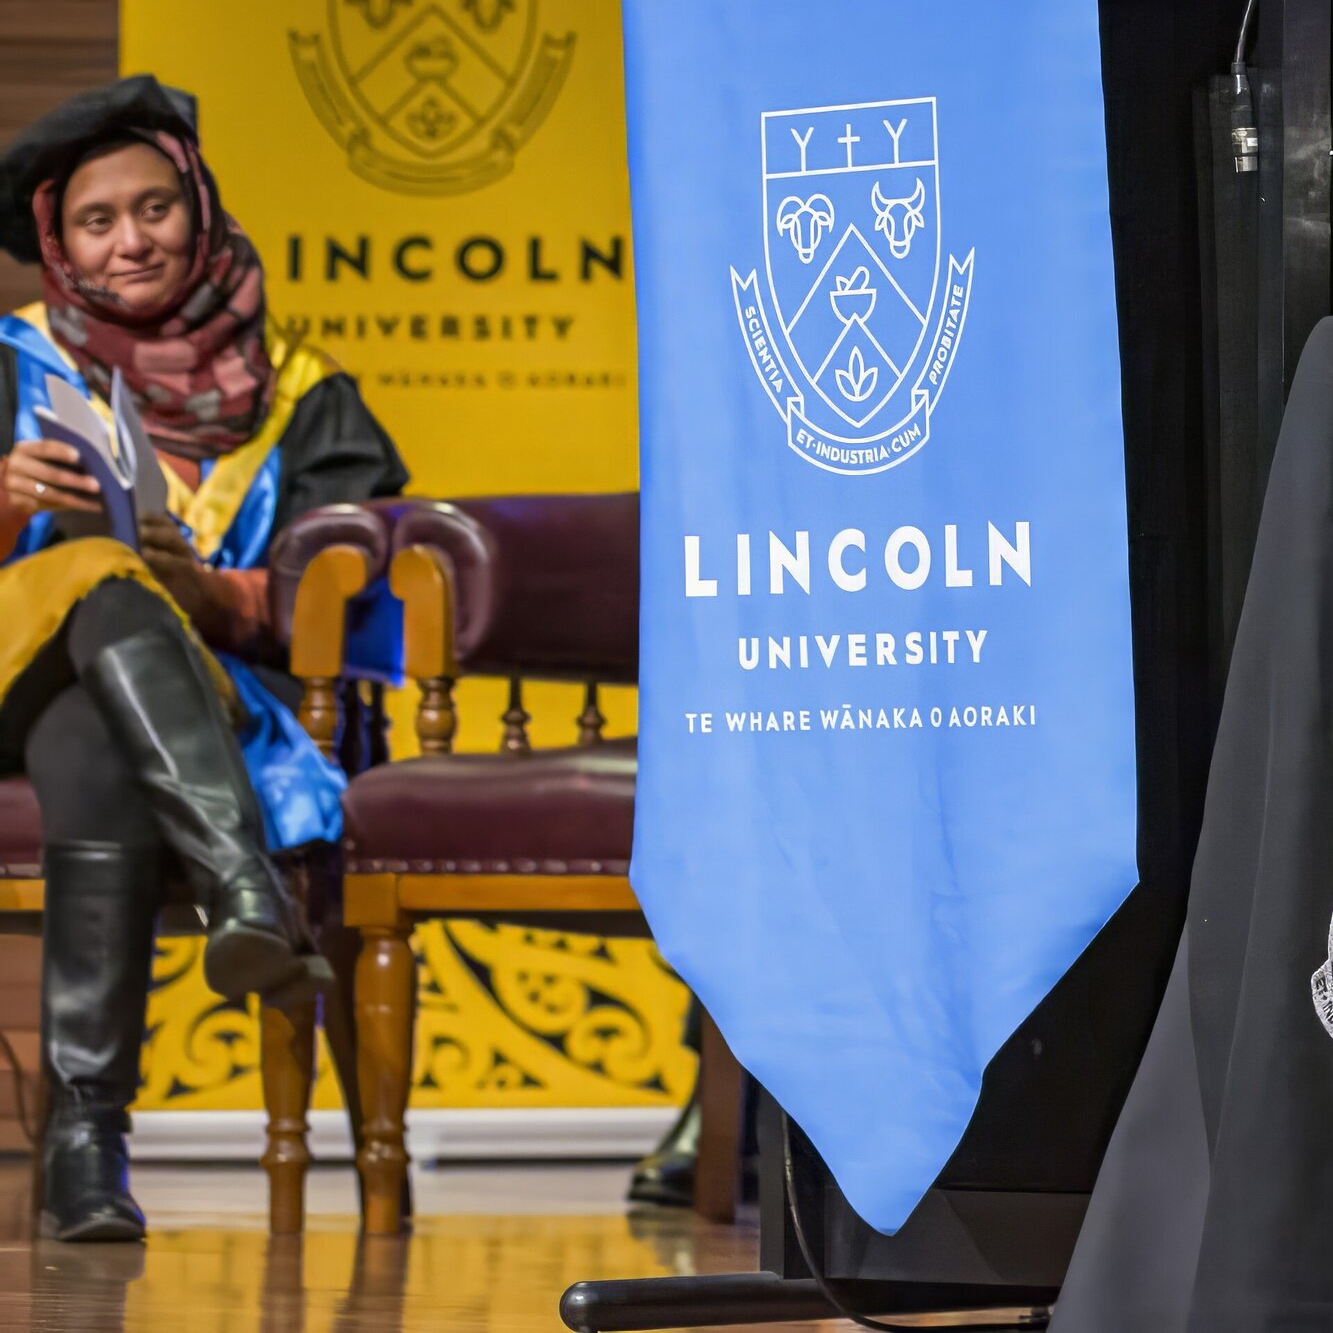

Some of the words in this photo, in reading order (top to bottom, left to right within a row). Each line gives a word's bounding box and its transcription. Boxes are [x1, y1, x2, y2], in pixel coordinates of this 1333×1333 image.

[287, 235, 624, 283] INCOLN
[744, 305, 785, 394] SCIENTIA
[928, 283, 964, 386] PROBITATE
[684, 520, 1031, 597] LINCOLN
[738, 630, 988, 670] UNIVERSITY
[685, 713, 713, 734] TE
[725, 710, 812, 733] WHARE
[820, 703, 923, 731] WĀNAKA
[930, 706, 942, 729] O
[949, 705, 1036, 727] AORAKI
